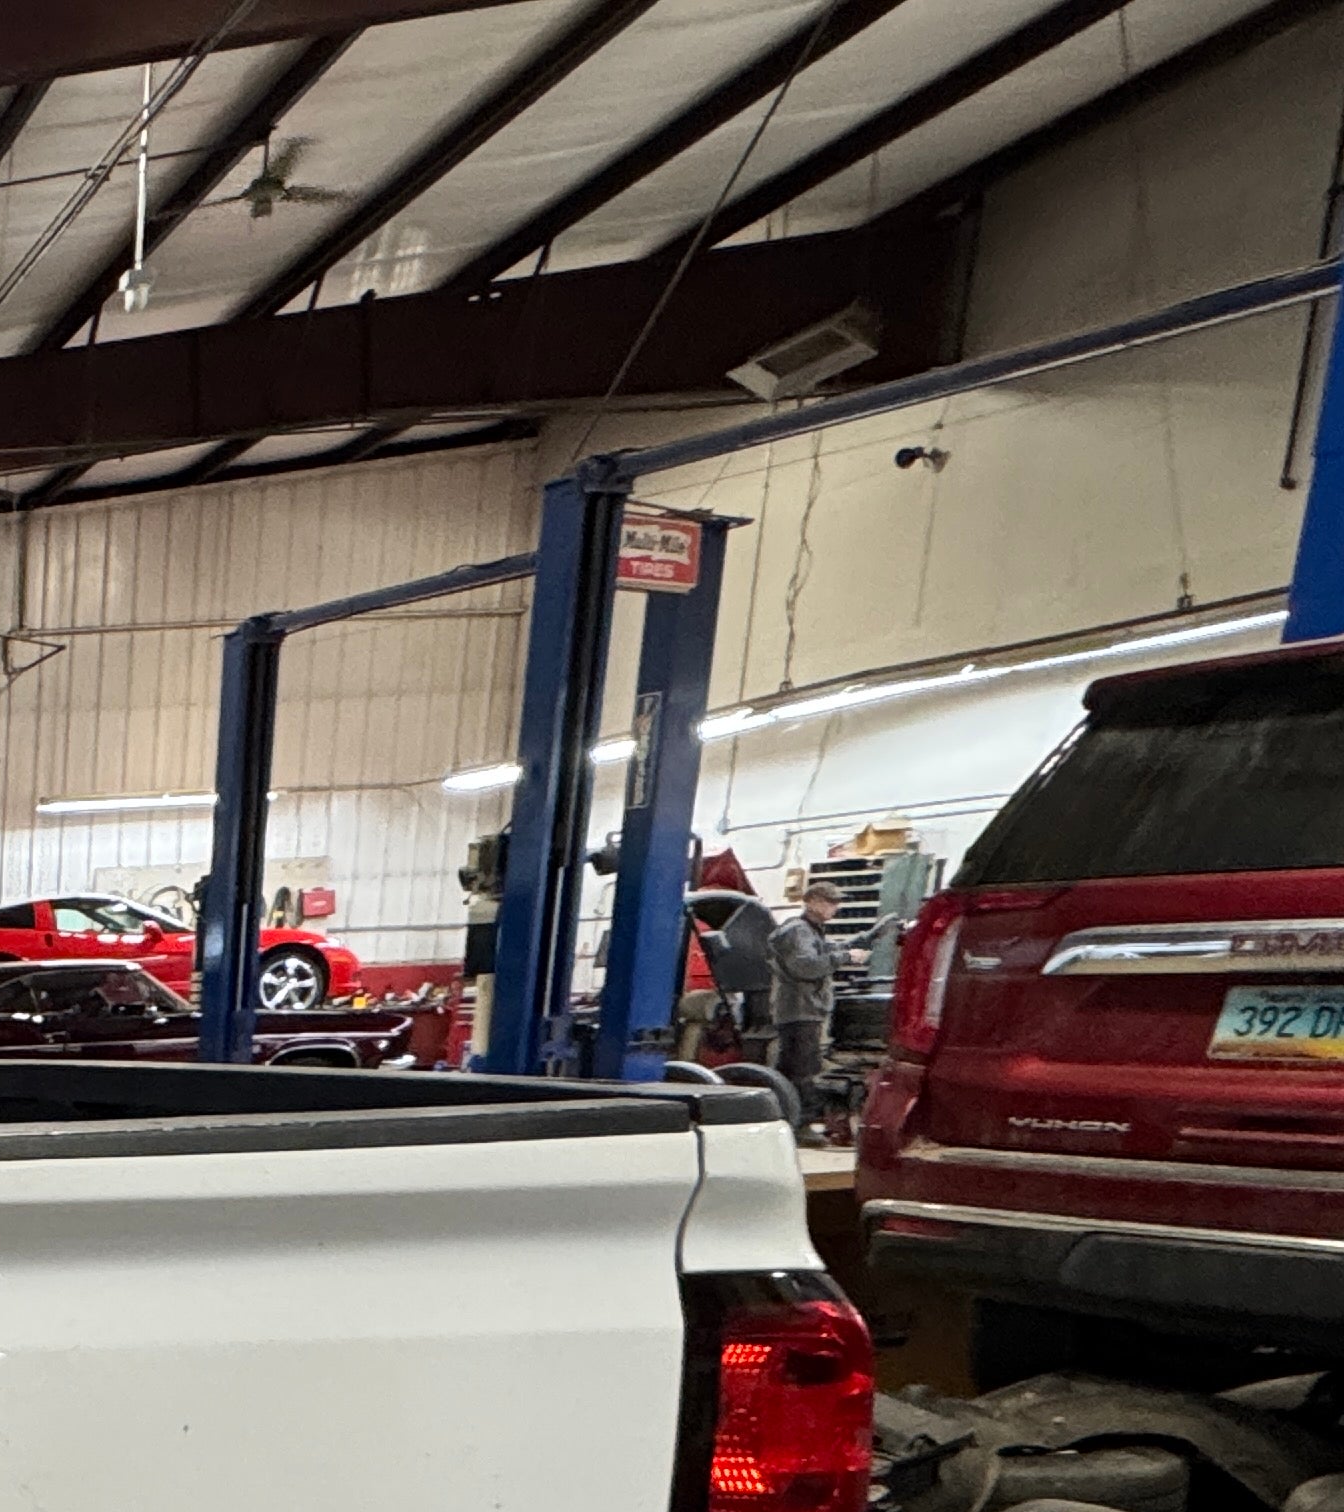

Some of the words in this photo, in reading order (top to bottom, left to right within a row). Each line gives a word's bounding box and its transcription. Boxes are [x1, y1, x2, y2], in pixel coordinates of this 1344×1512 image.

[1230, 931, 1344, 956] GM
[1233, 1005, 1303, 1037] 392
[1008, 1116, 1132, 1132] YUKON
